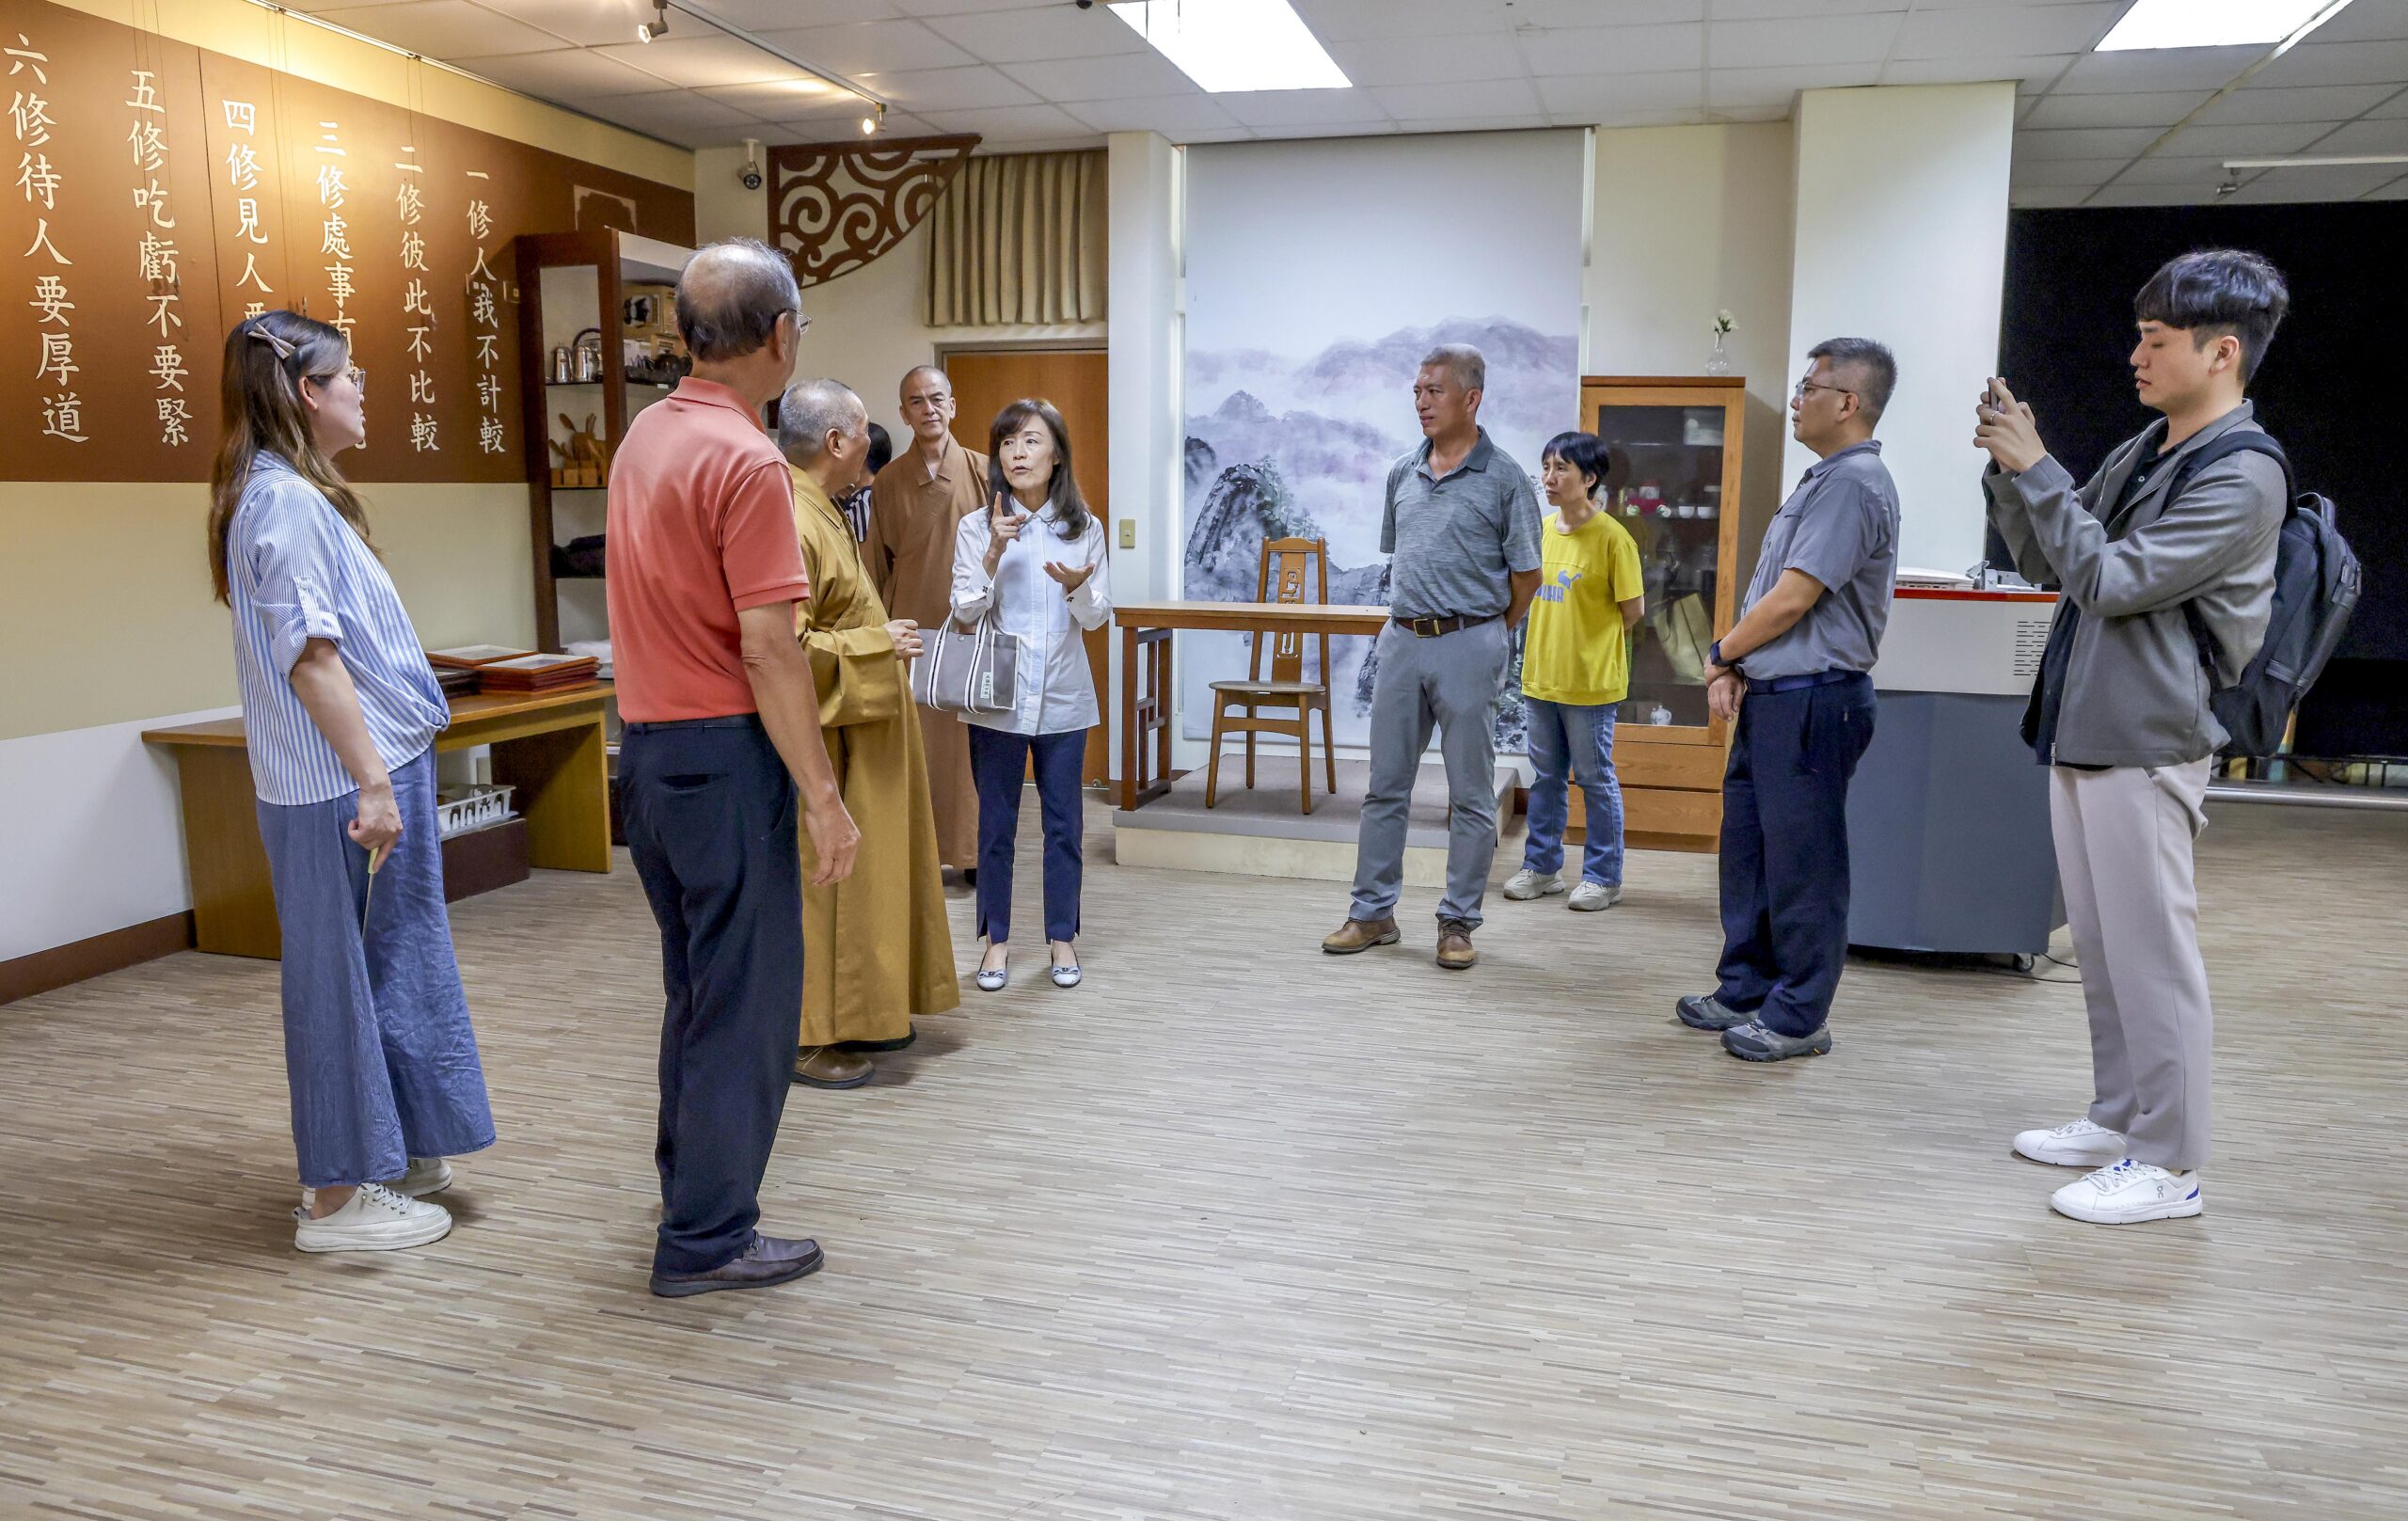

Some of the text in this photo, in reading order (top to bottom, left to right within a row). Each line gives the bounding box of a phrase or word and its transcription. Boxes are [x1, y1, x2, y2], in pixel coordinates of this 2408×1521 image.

[3, 32, 90, 444] 六修待人要厚道
[125, 70, 194, 448] 五修吃虧不要緊
[394, 146, 441, 453] 二修彼此不比較
[466, 169, 506, 454] 一修人我不計較
